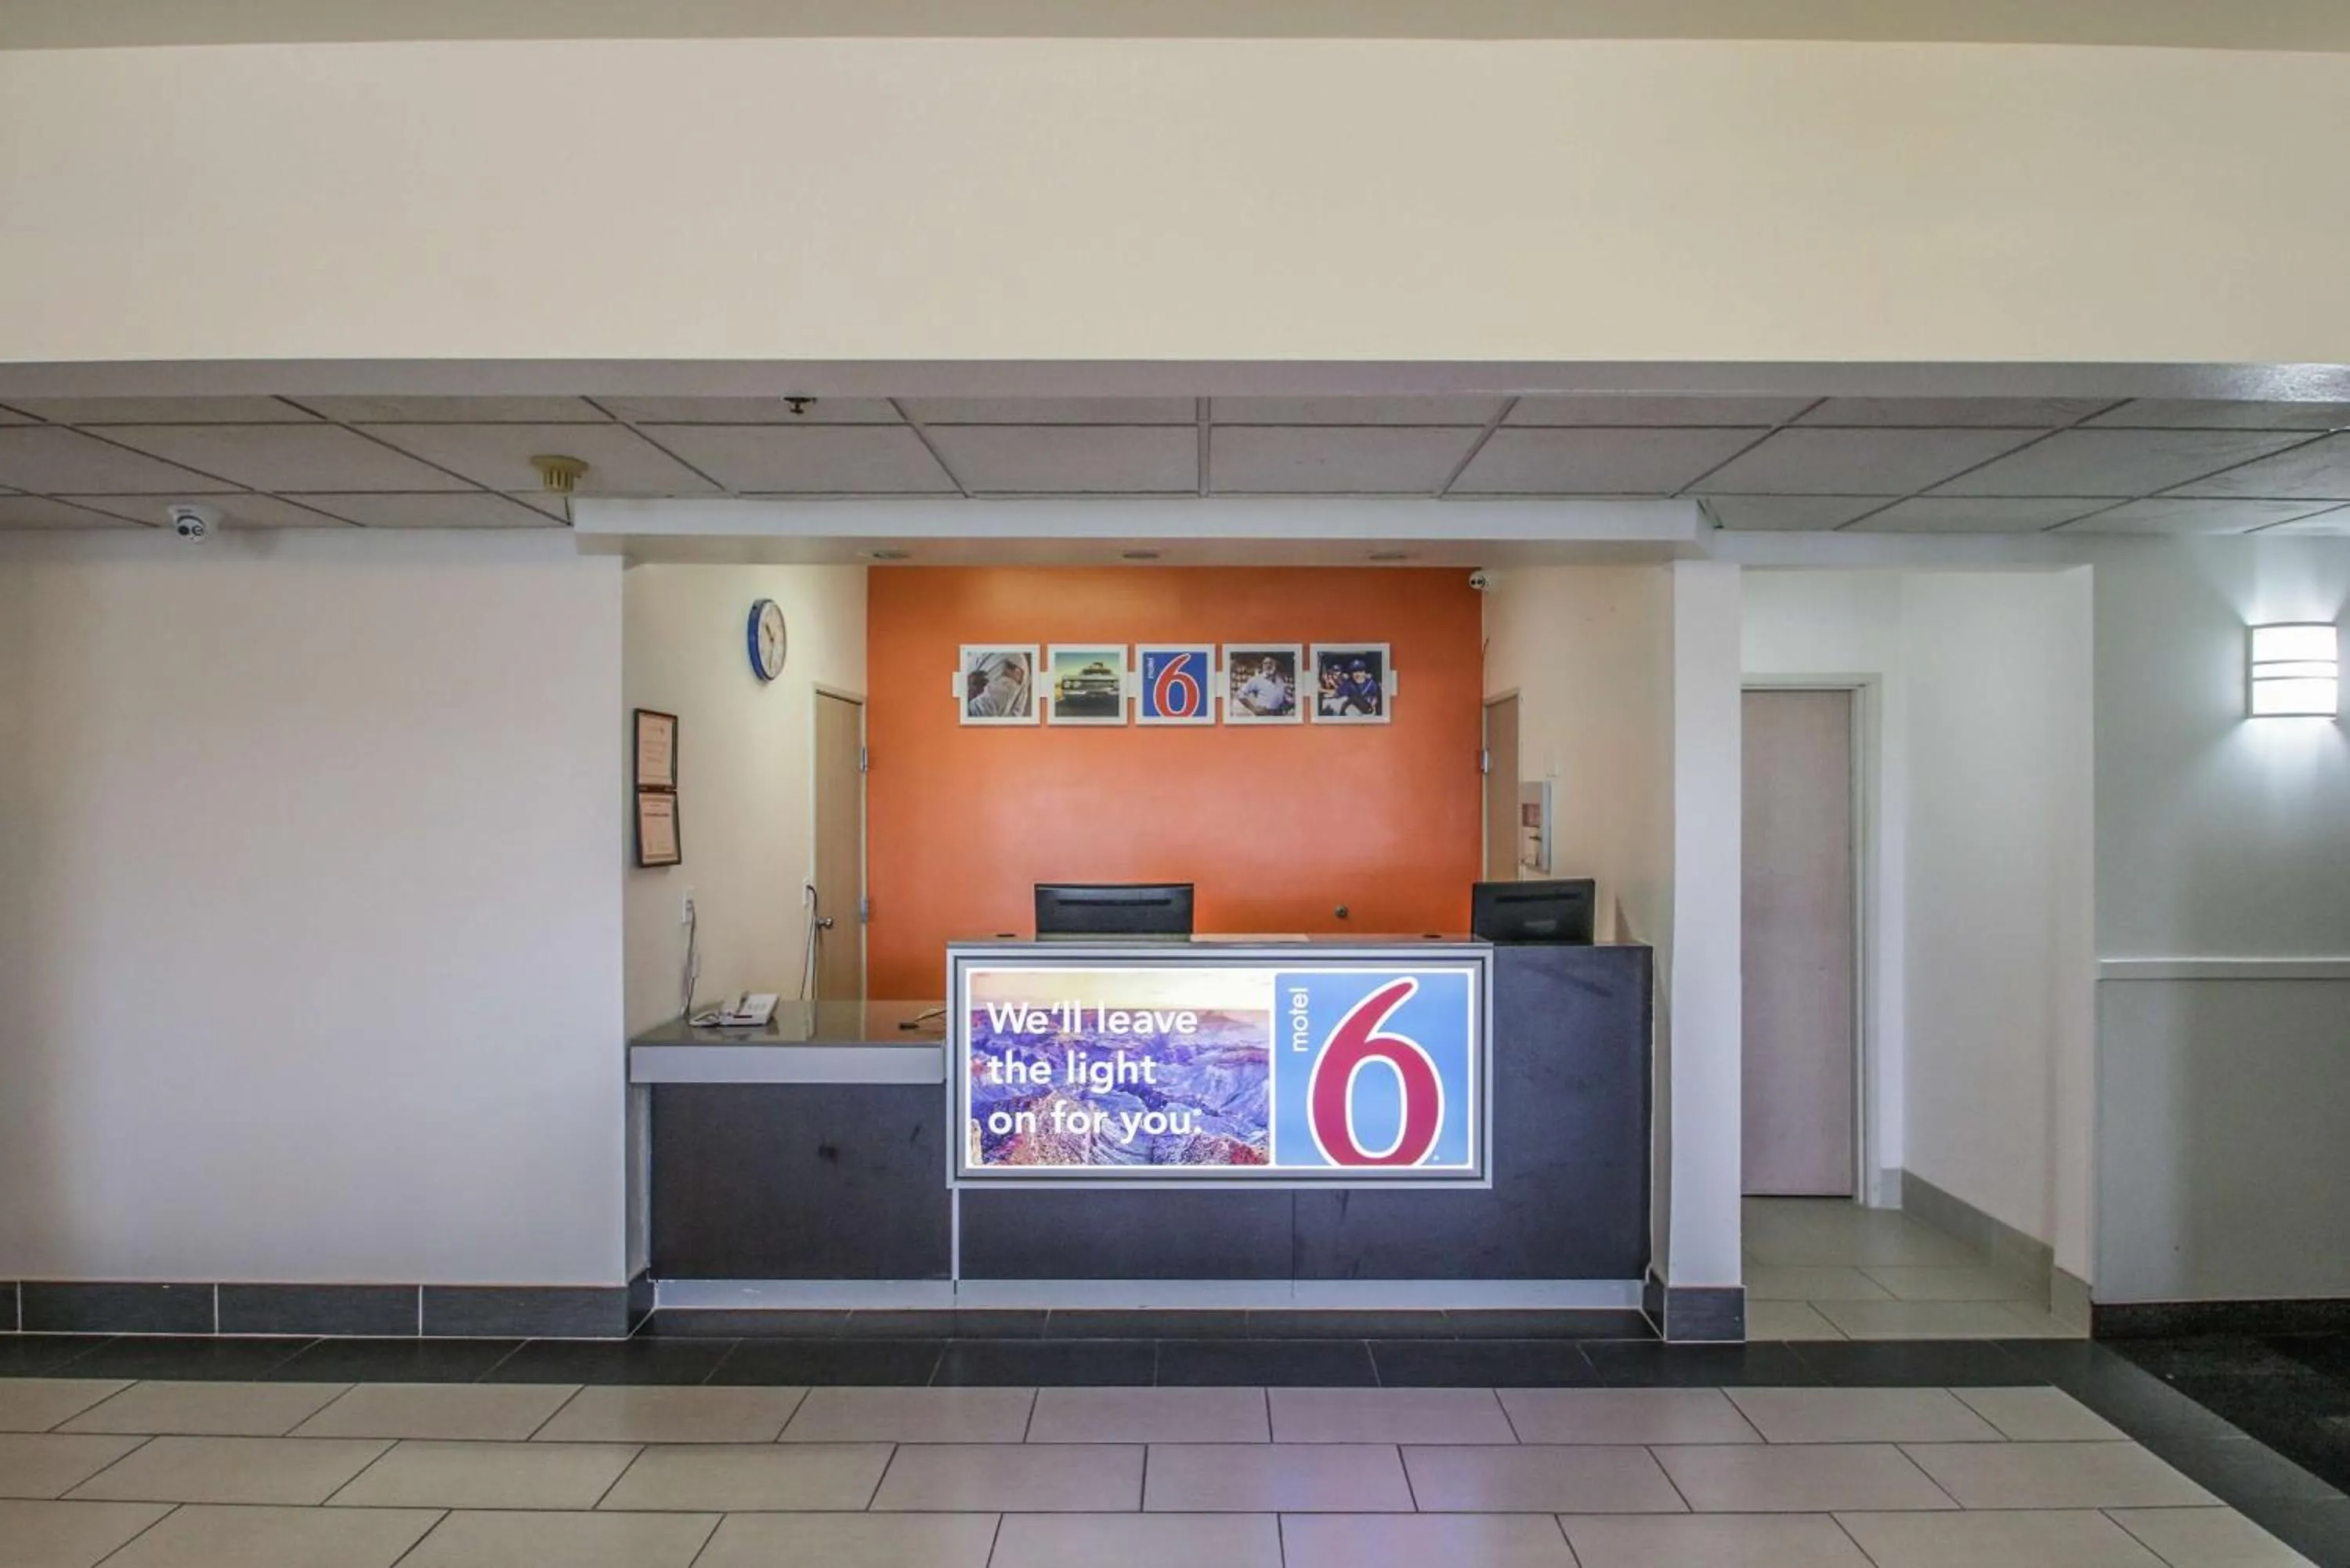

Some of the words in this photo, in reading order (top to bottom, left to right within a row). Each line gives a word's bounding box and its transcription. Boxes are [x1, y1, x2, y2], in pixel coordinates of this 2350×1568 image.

[1153, 653, 1200, 717] 6
[986, 1000, 1081, 1034] We'll
[1097, 1000, 1198, 1034] leave
[987, 1050, 1052, 1084] the
[1067, 1050, 1157, 1094] light
[1289, 988, 1309, 1052] motel
[1307, 976, 1444, 1166] 6
[988, 1111, 1036, 1135] on
[1051, 1100, 1108, 1134] for
